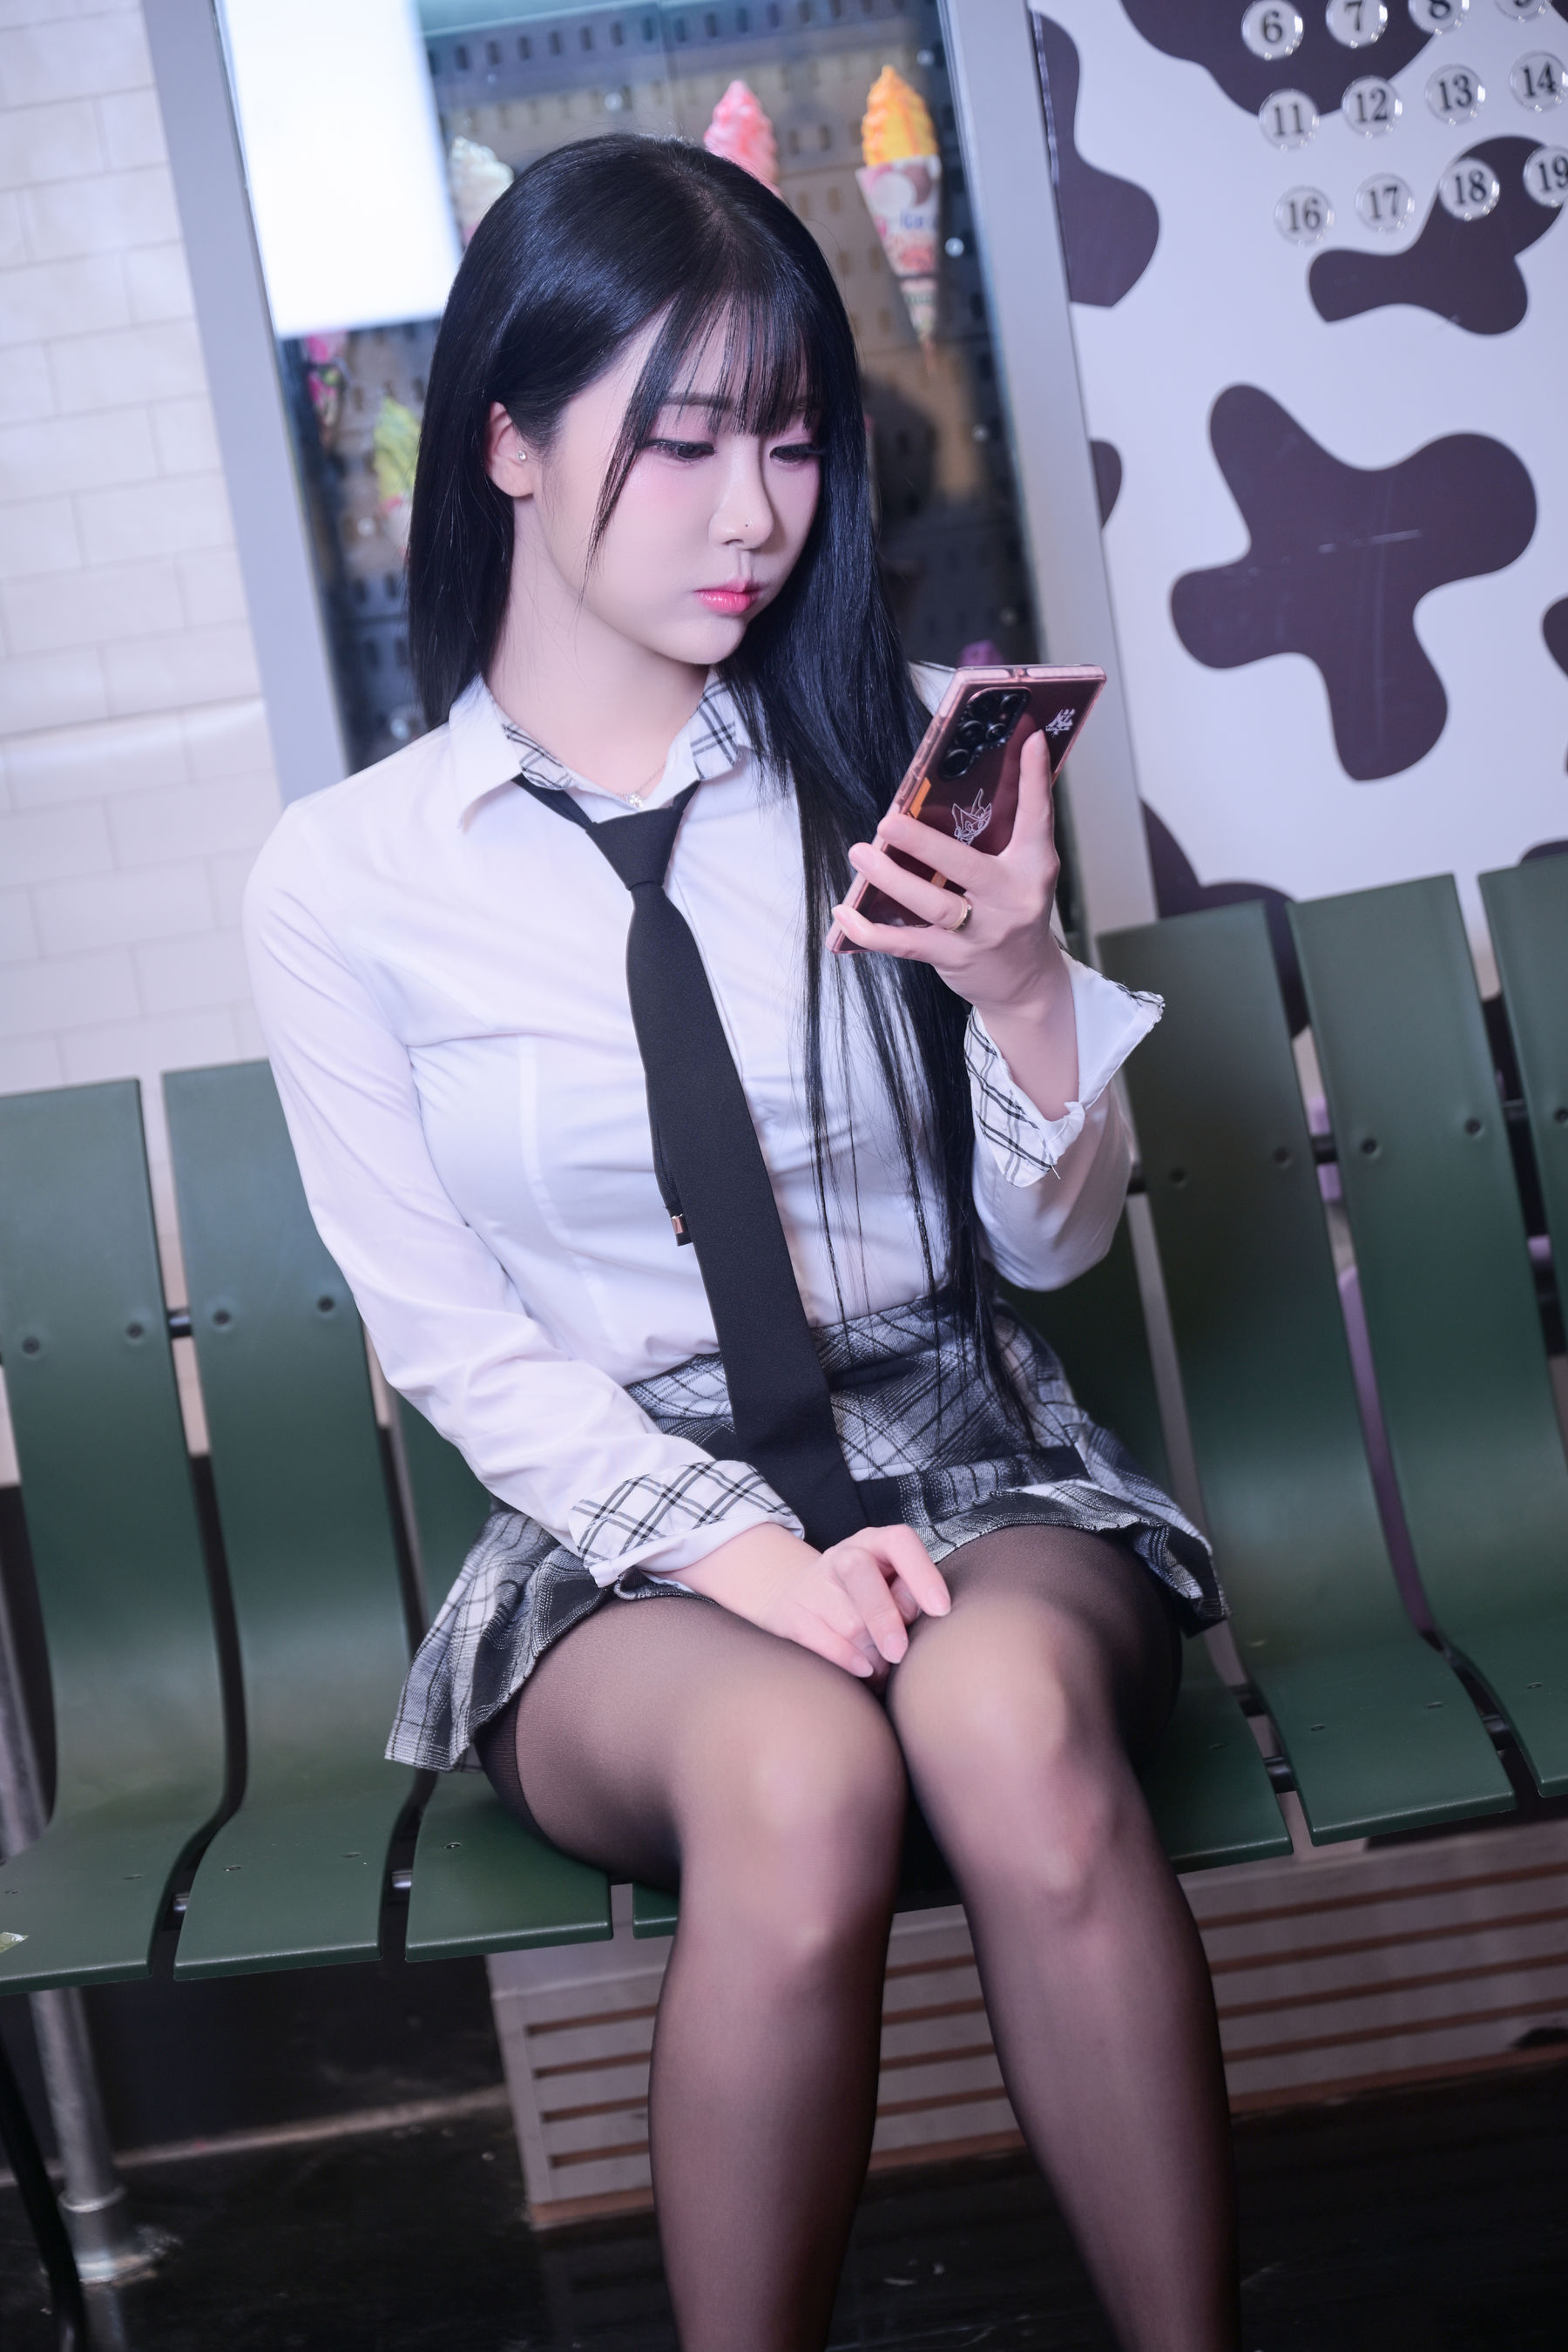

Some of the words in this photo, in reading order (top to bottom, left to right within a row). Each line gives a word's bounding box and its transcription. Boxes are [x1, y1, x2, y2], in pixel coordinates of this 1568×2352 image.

[1262, 10, 1283, 44] 6
[1344, 0, 1368, 31] 7
[1273, 103, 1305, 136] 11
[1355, 88, 1389, 123] 12
[1438, 74, 1473, 112] 13
[1521, 62, 1558, 98] 14
[1288, 199, 1321, 231] 16
[1369, 186, 1399, 220] 17
[1452, 170, 1487, 206] 18
[1538, 155, 1568, 192] 19
